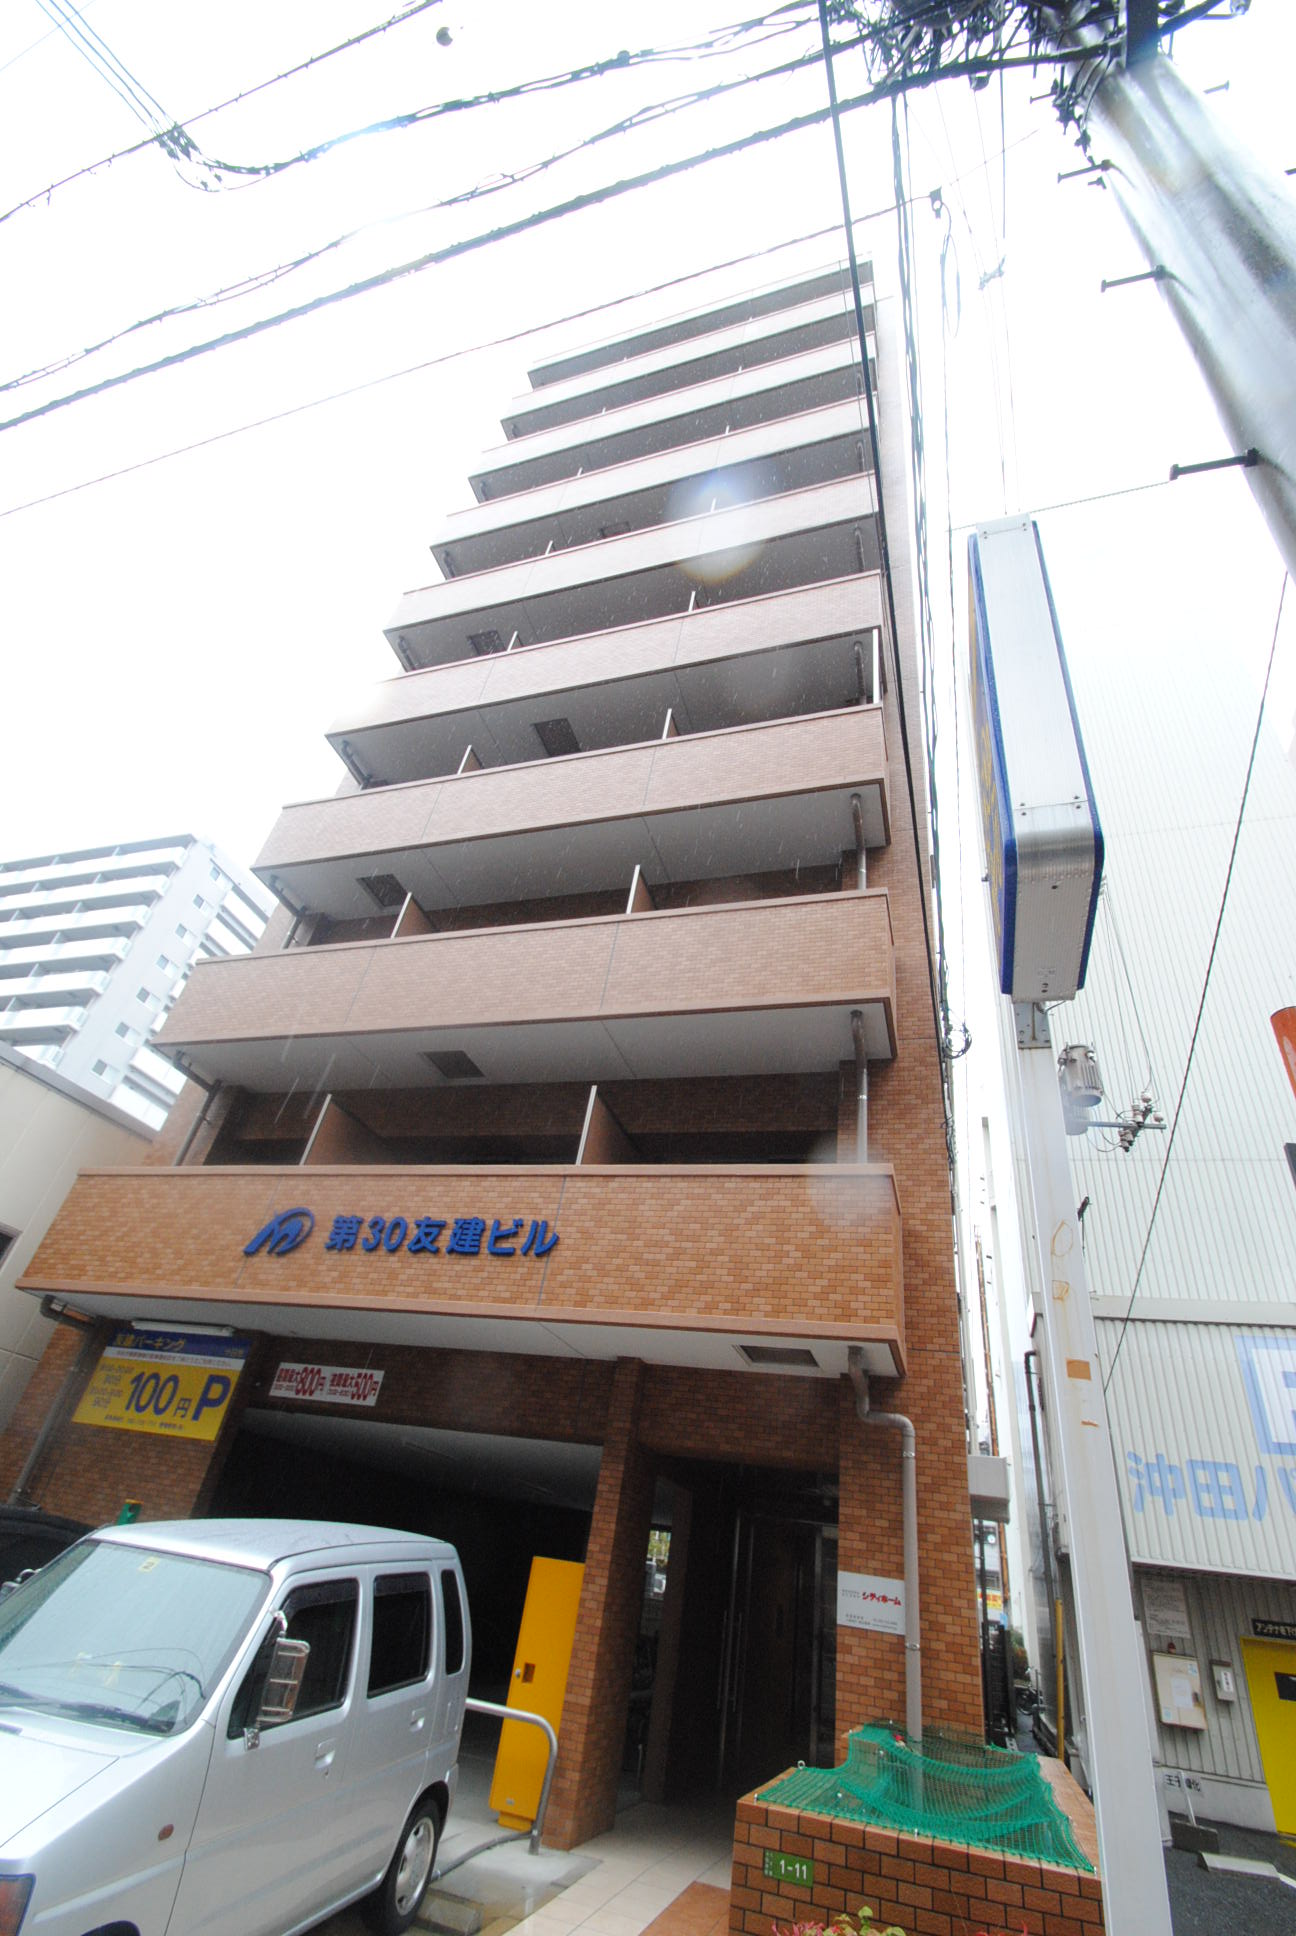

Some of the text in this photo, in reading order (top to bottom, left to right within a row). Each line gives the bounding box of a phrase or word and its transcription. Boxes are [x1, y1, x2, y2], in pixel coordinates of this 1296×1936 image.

[325, 1214, 560, 1258] 第30友建ビル
[191, 1374, 231, 1421] P
[780, 1859, 807, 1880] 1-11
